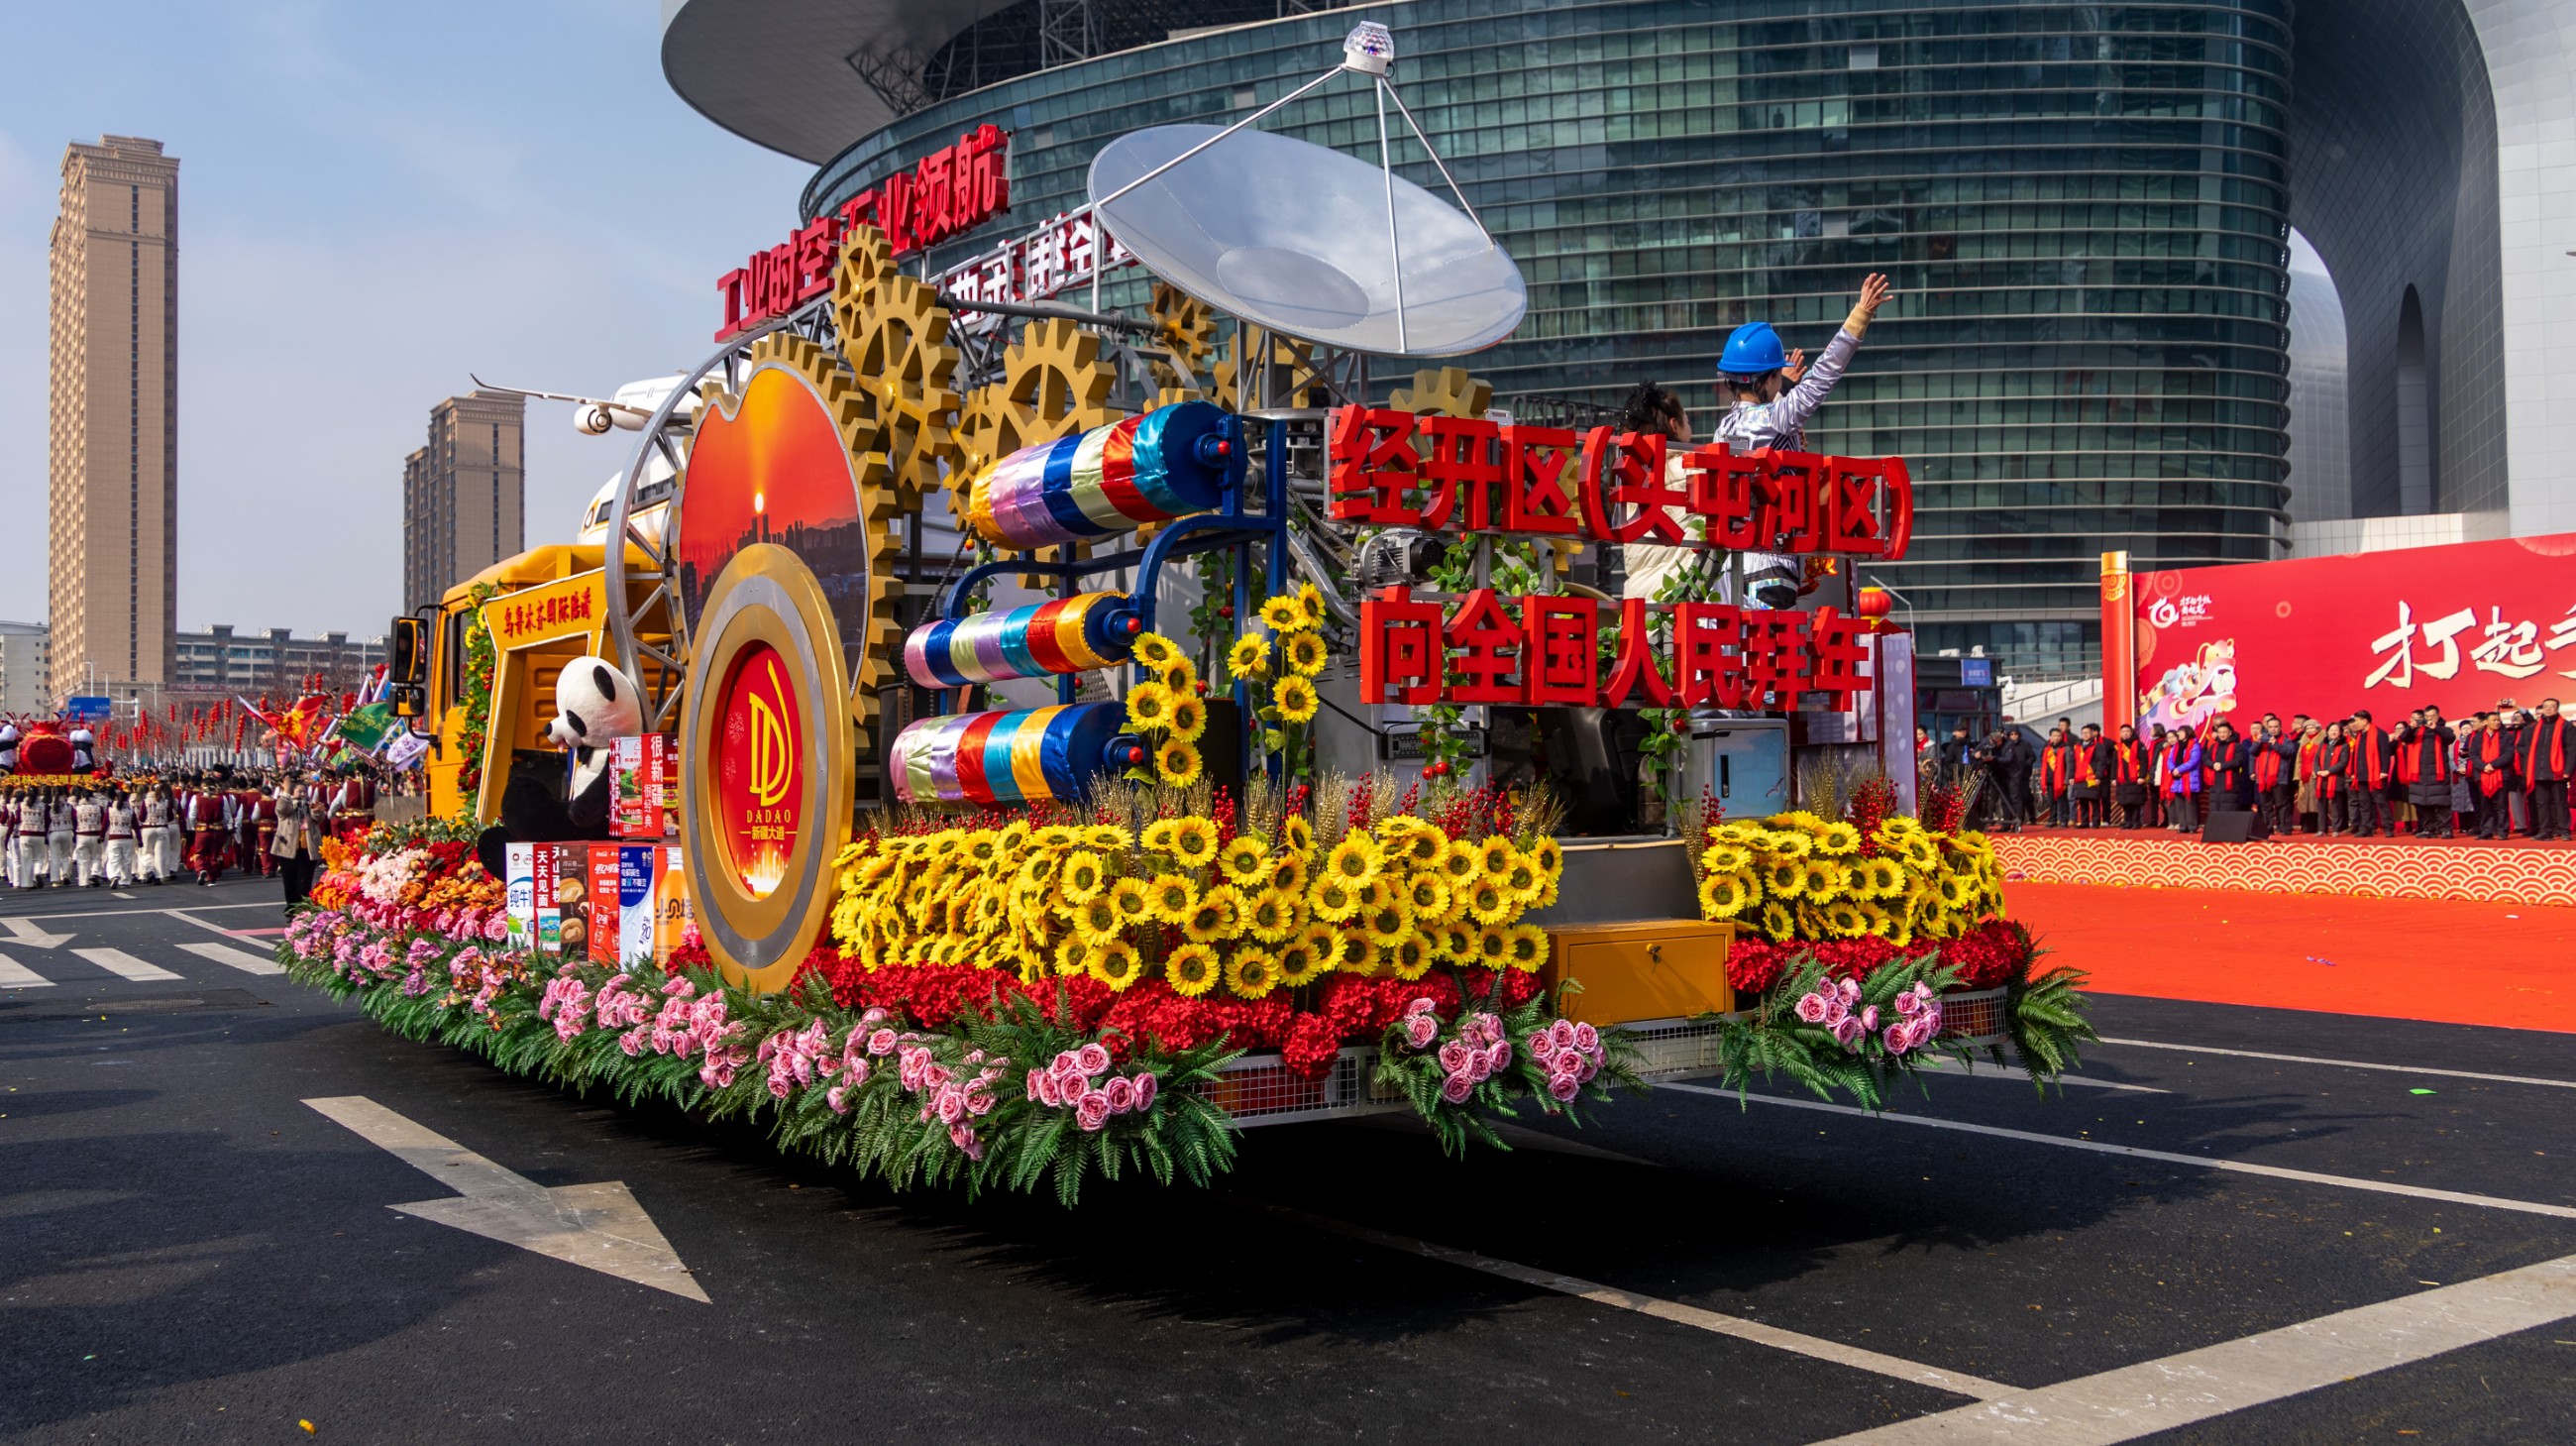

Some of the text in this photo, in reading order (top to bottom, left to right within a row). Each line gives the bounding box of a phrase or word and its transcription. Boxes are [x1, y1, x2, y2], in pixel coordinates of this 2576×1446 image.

[714, 124, 1009, 344] 工业时空 工业领航
[1329, 403, 1914, 561] 经开区(头屯河区)
[1359, 586, 1873, 713] 向全国人民拜年
[651, 735, 663, 807] 很新疆
[644, 784, 653, 828] 很经典
[746, 810, 792, 824] DADAO
[751, 825, 786, 840] 新疆大道
[537, 850, 549, 907] 天天见面
